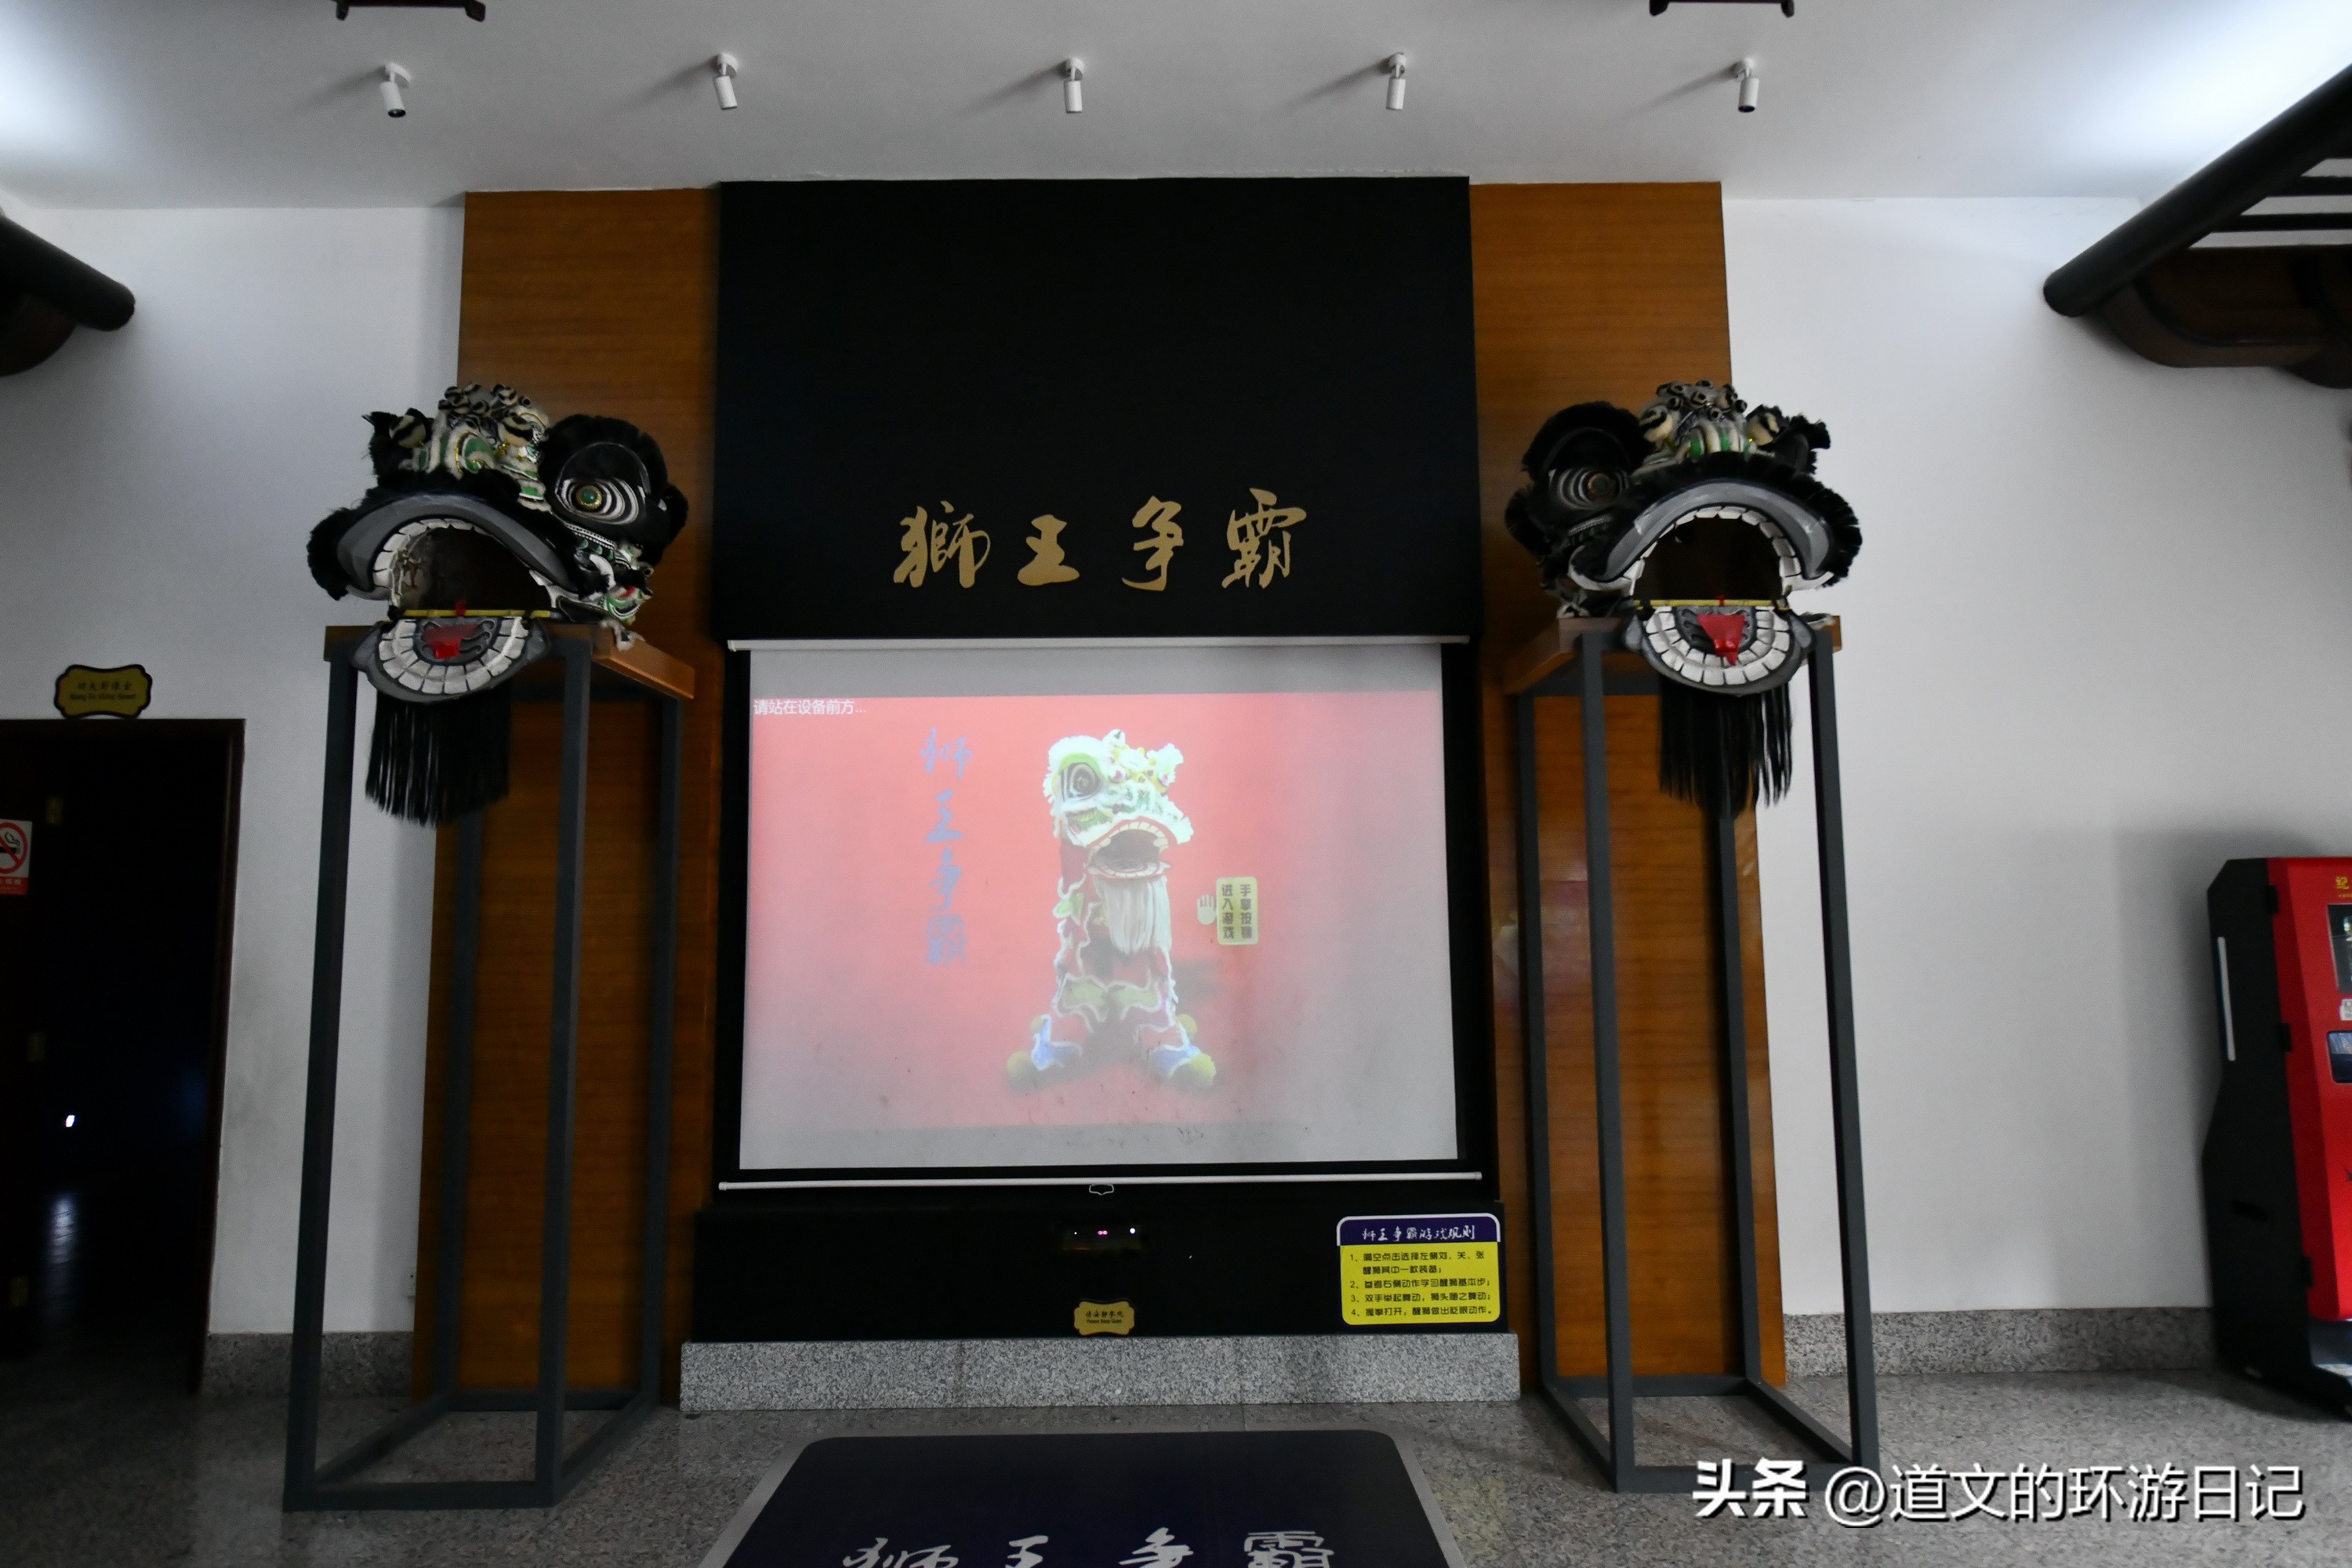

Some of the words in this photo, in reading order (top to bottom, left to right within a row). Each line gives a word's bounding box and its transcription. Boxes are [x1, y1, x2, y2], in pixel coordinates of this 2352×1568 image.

[1362, 1225, 1476, 1242] 狮王争霸游戏规则
